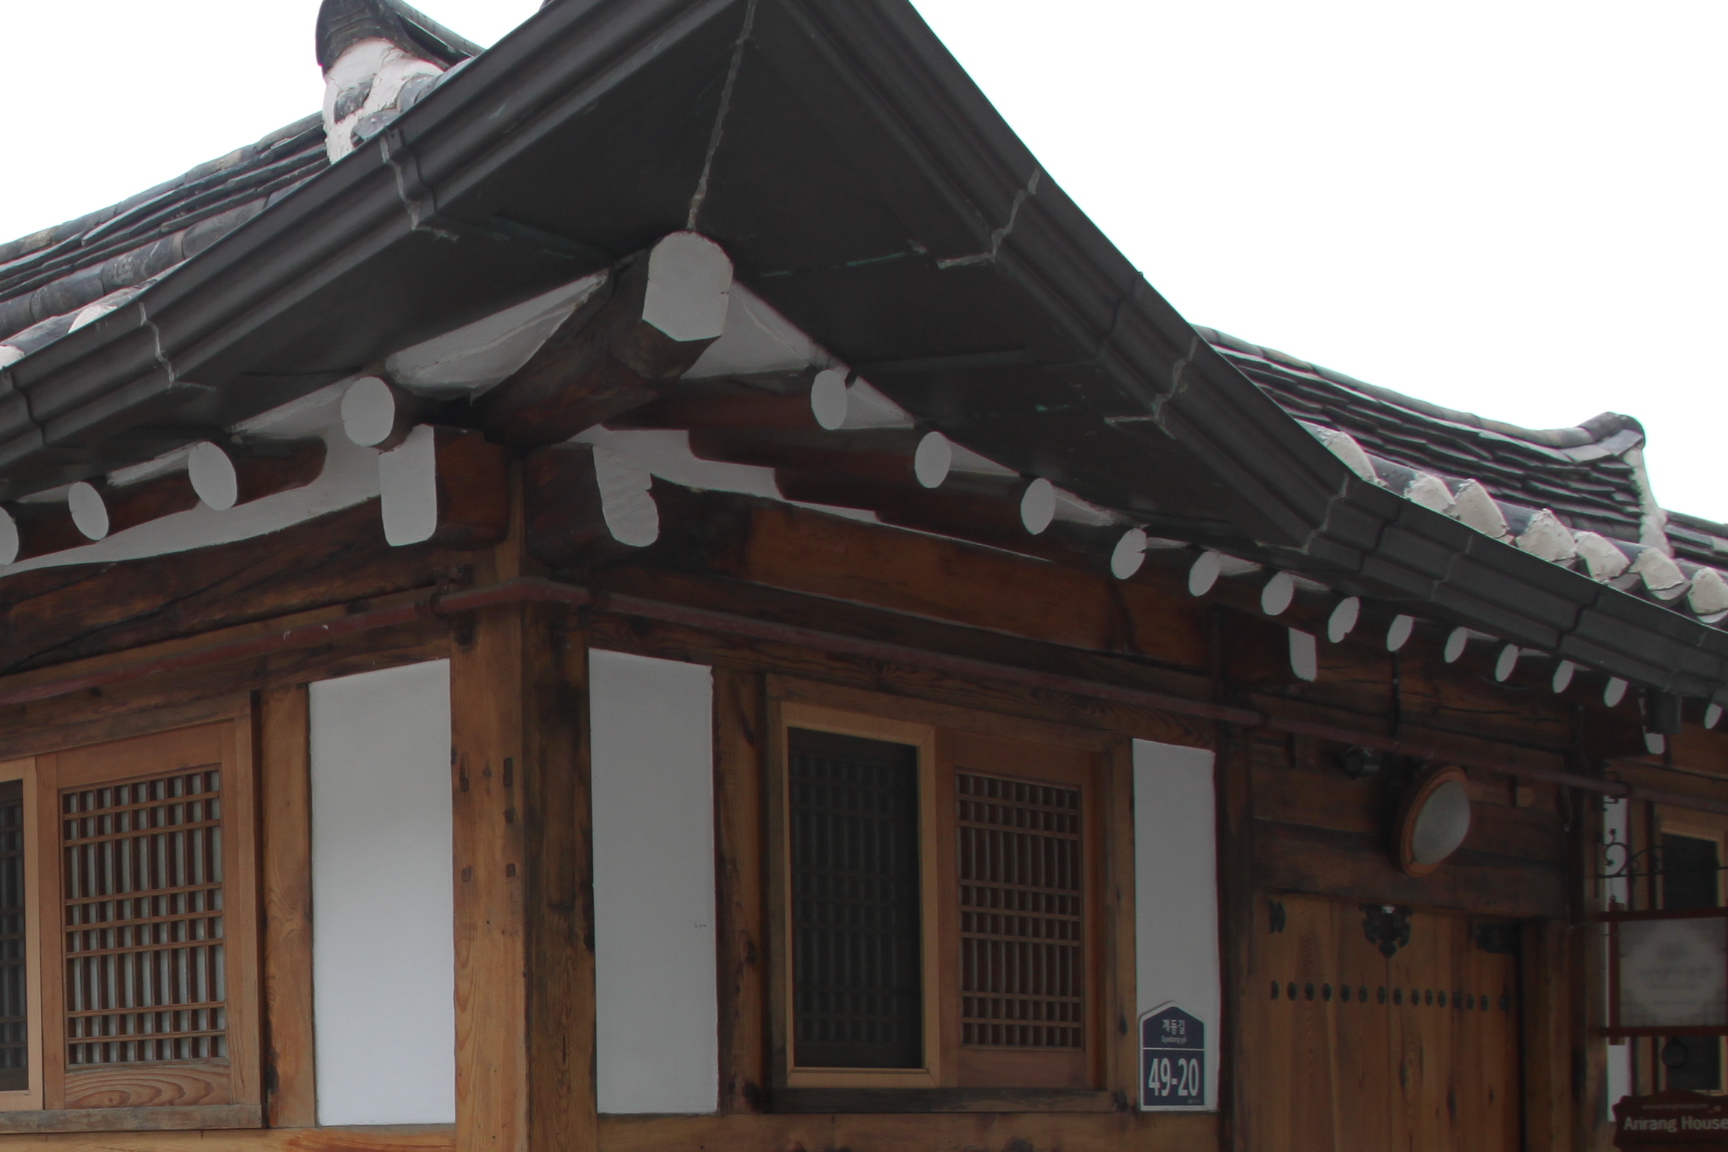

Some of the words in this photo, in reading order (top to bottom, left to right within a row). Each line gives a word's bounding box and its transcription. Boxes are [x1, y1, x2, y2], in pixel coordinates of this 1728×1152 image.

[1162, 1019, 1185, 1035] 계동길
[1148, 1057, 1199, 1097] 49-20
[1623, 1115, 1679, 1133] Arirang
[1681, 1115, 1728, 1130] House
